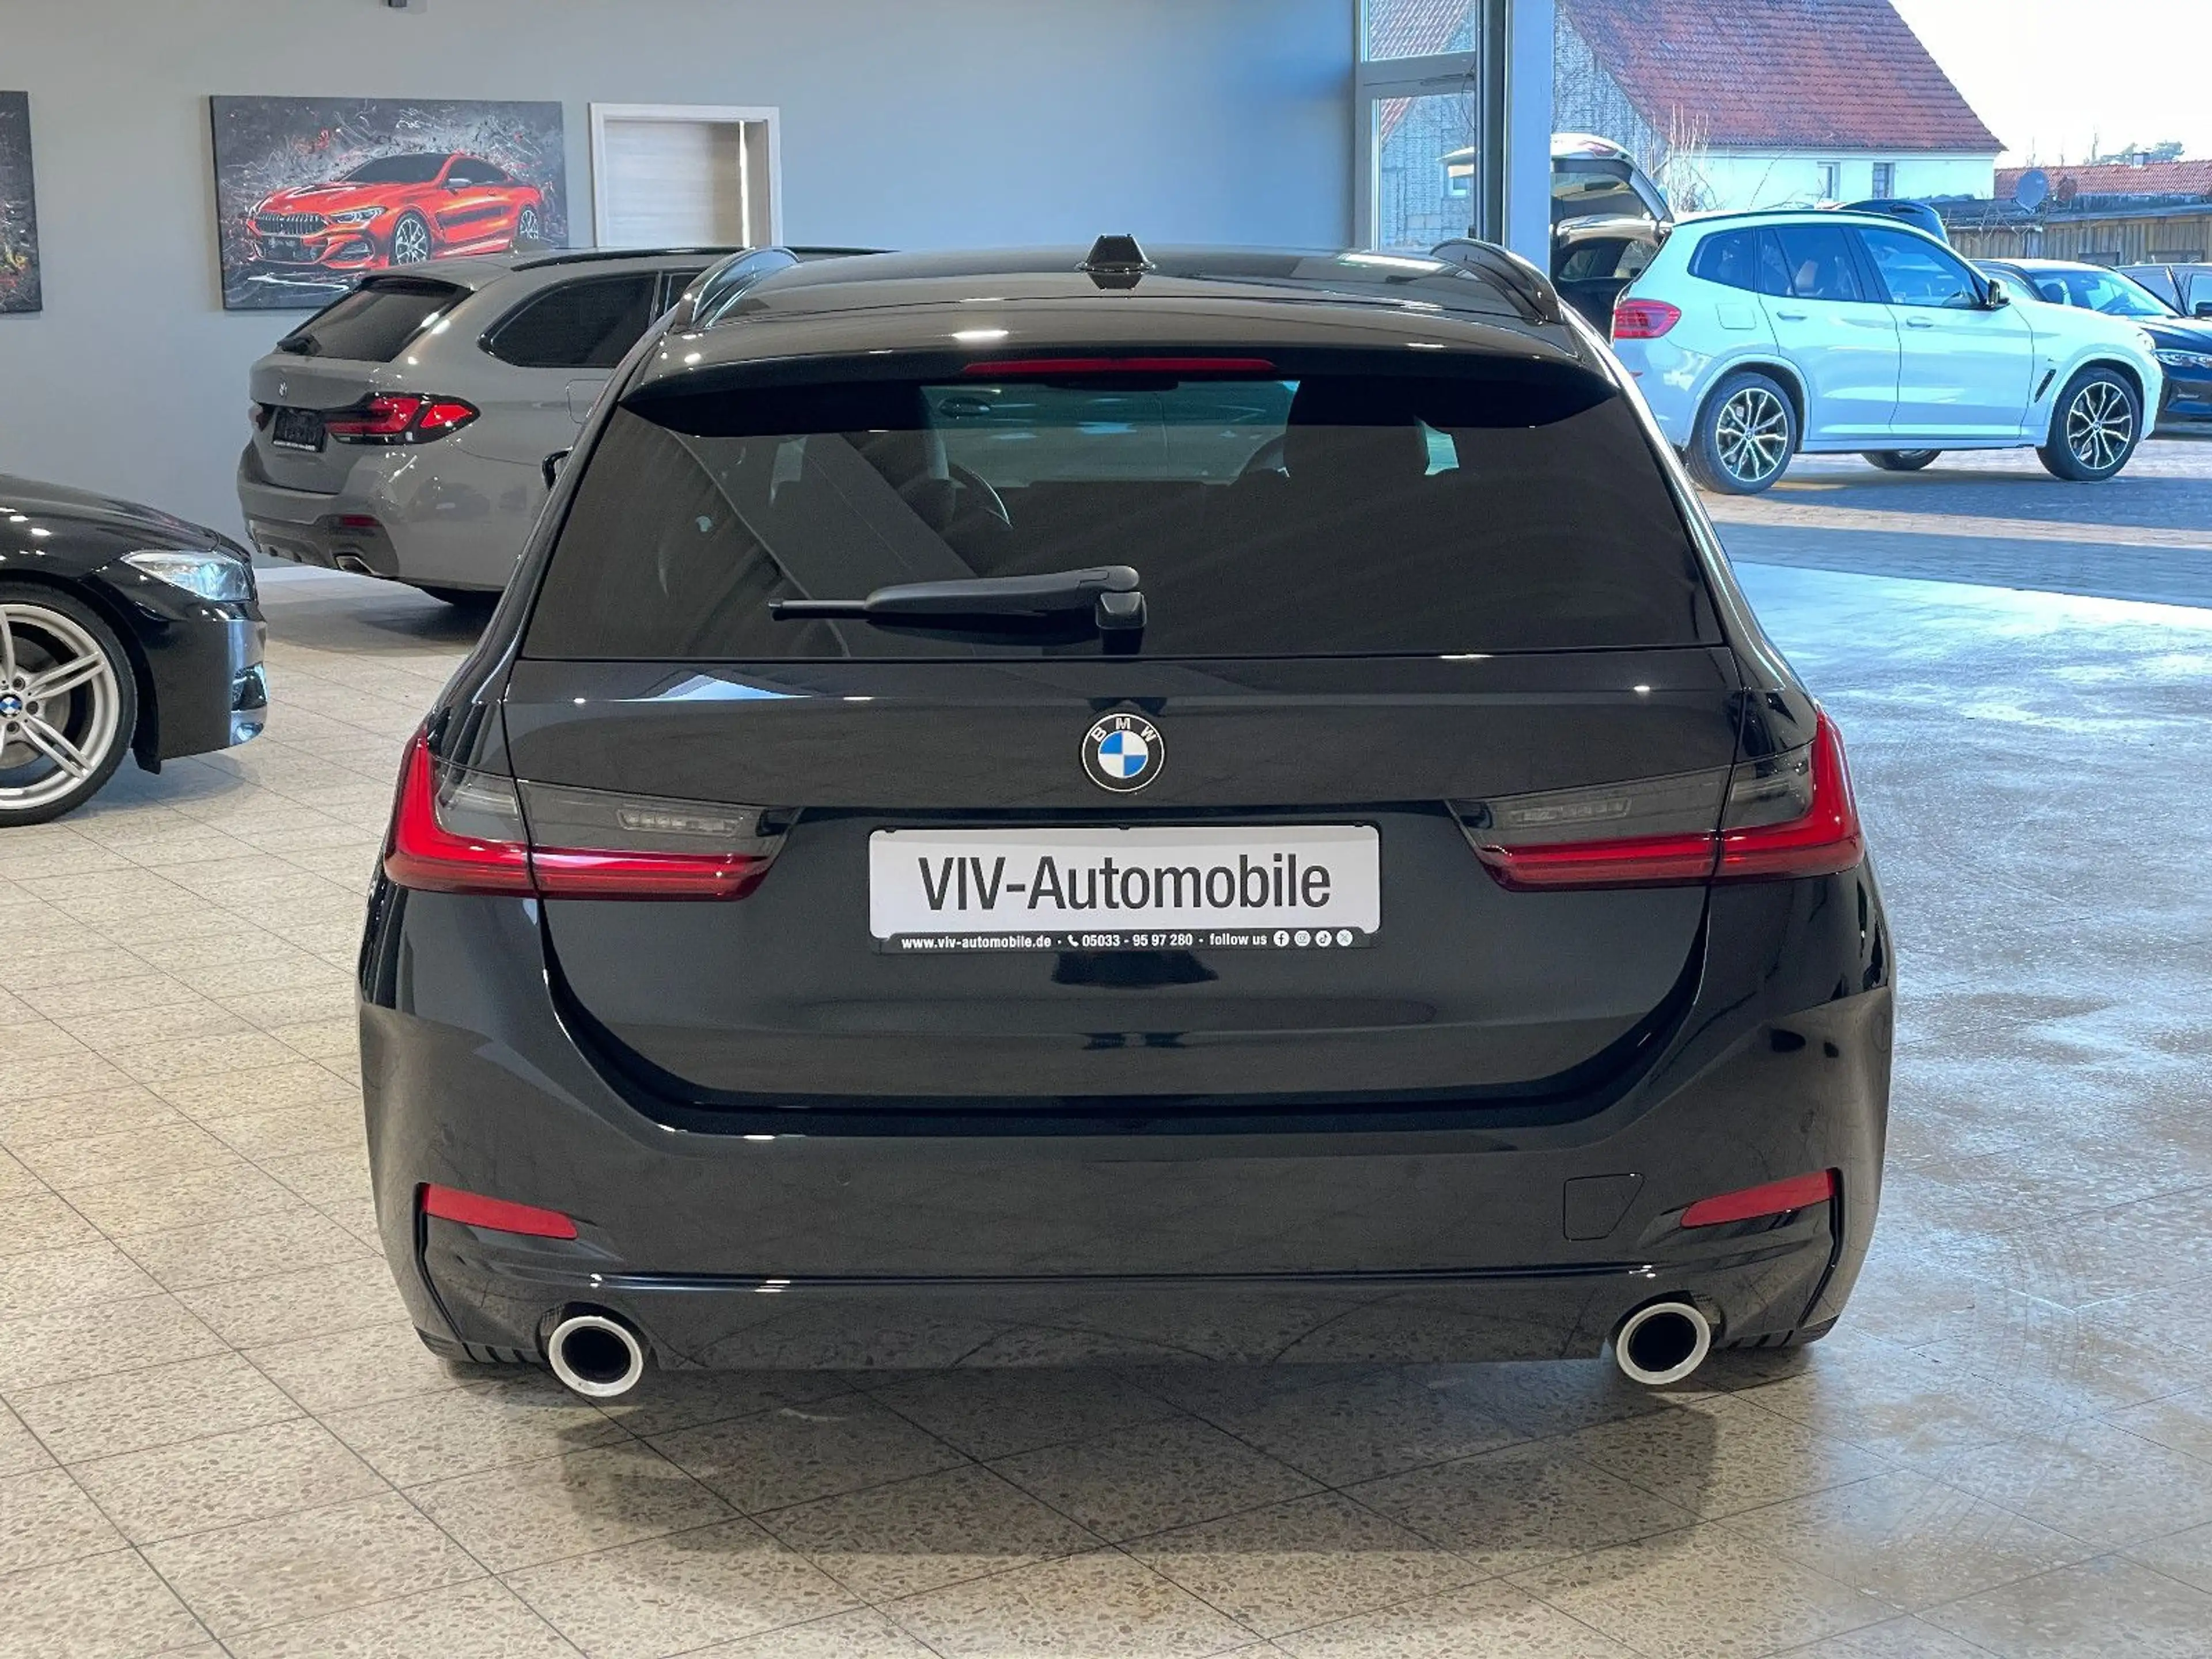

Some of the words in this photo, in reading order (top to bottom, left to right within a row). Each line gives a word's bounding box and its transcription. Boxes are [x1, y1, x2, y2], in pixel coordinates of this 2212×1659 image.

[1090, 717, 1157, 743] BMW
[919, 853, 1331, 910] VIV-Automobile
[902, 935, 1051, 949] www.viv-automobile.de
[1082, 934, 1120, 947] 05033
[1132, 934, 1148, 946] 95
[1152, 934, 1166, 946] 97
[1169, 933, 1193, 946] 280
[1210, 933, 1250, 946] follow
[1253, 934, 1267, 945] us
